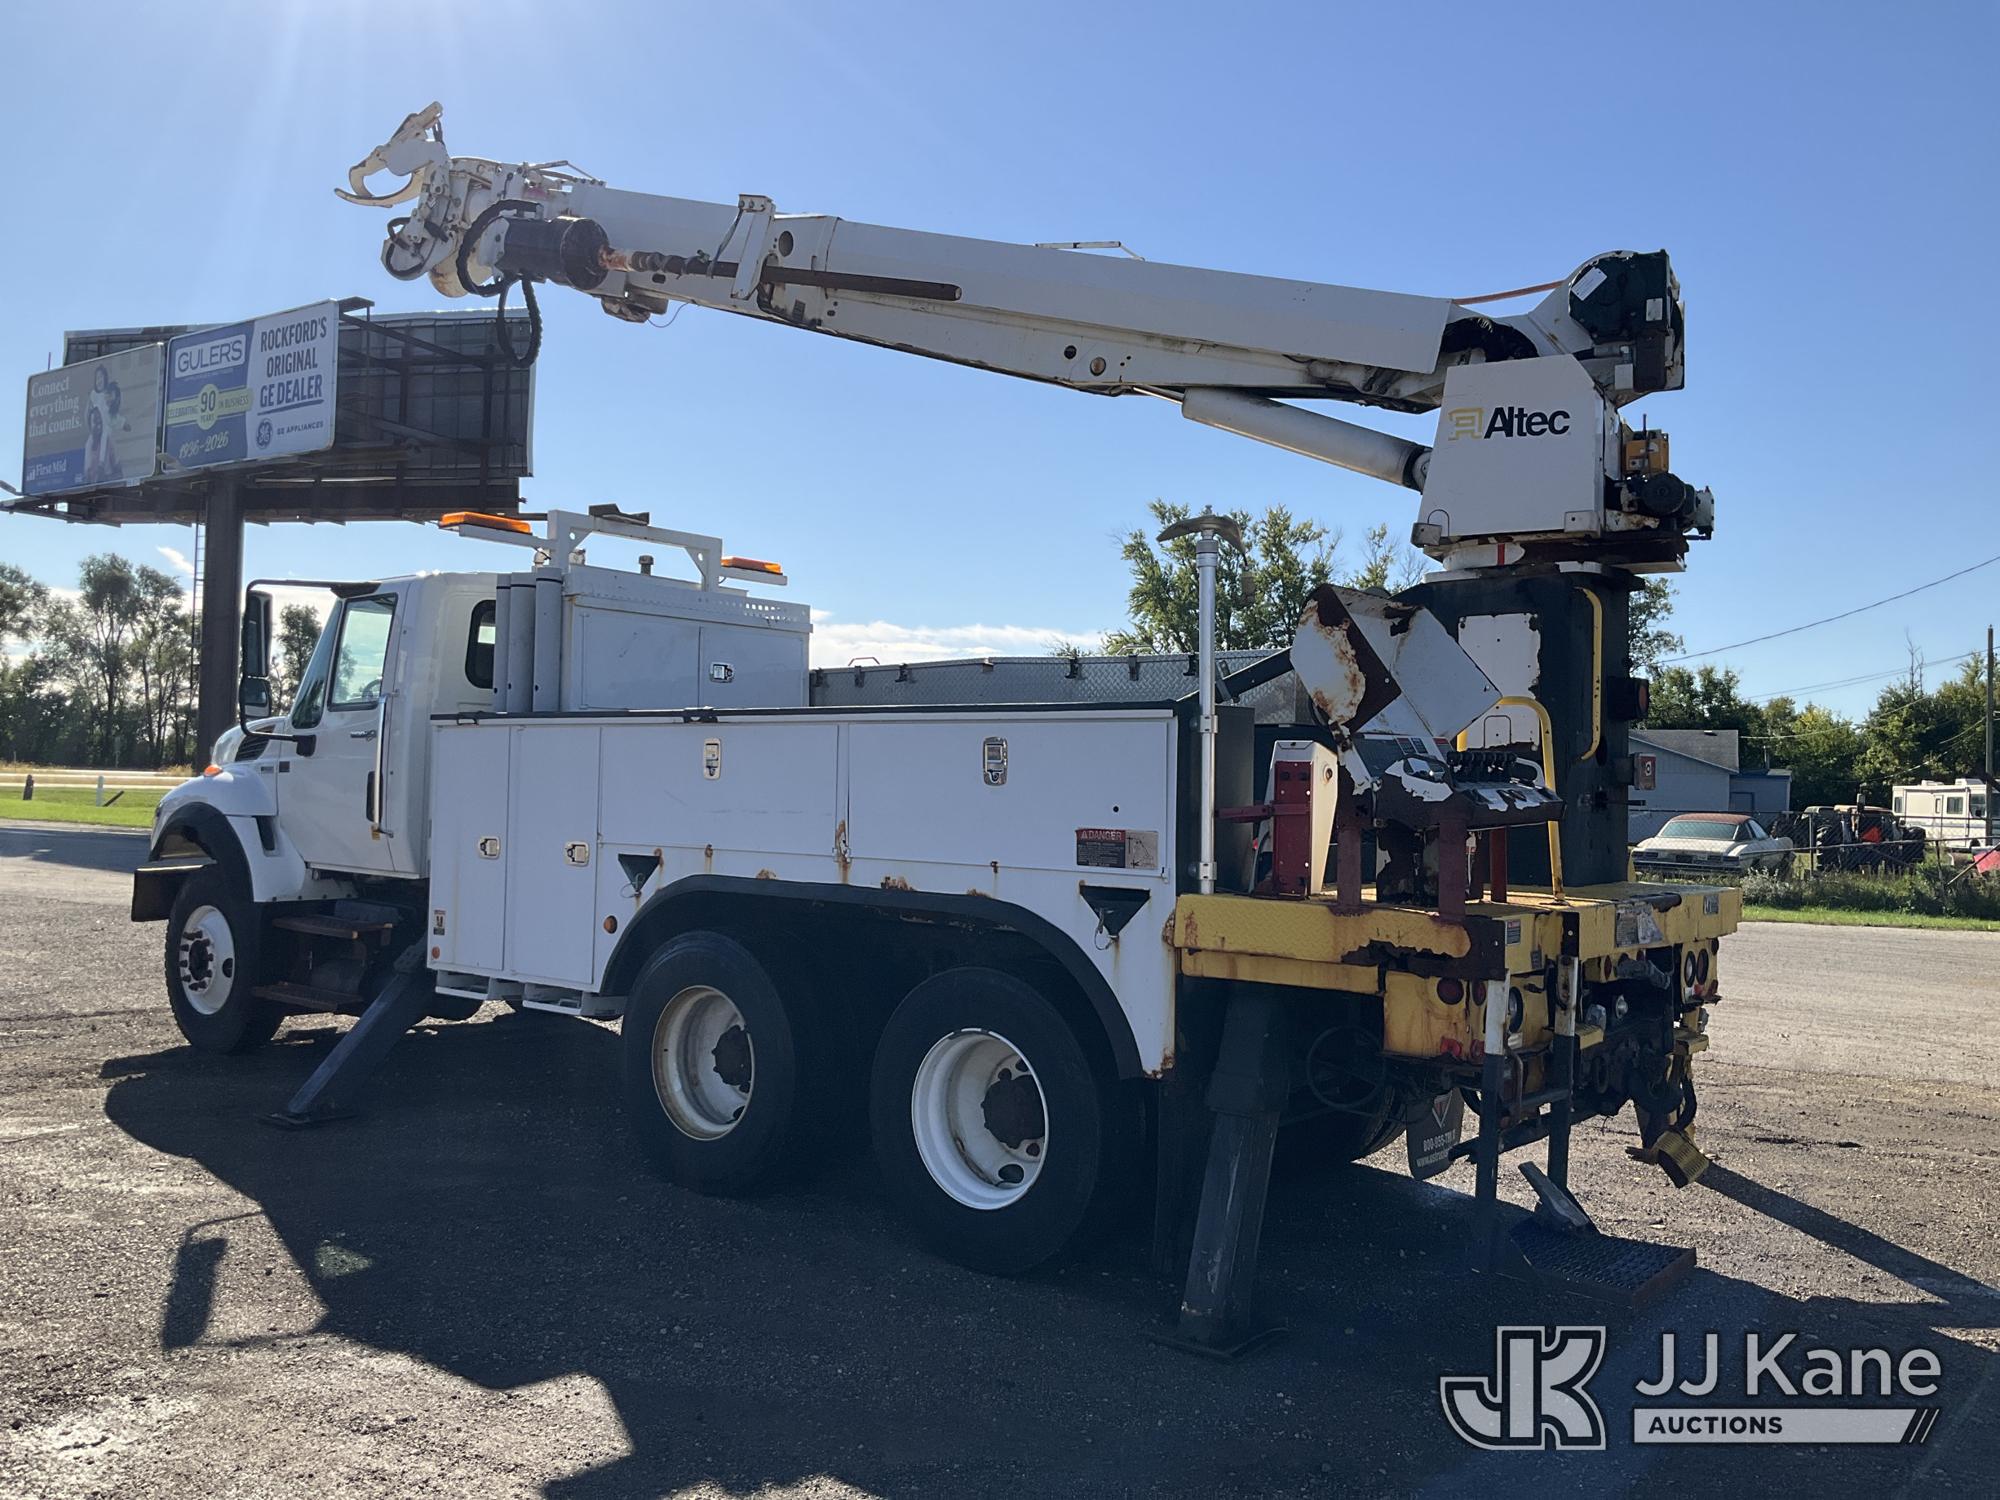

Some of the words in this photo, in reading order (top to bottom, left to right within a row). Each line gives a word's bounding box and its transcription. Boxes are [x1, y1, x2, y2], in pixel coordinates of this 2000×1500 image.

[260, 316, 327, 353] ROCKFORD'S
[177, 340, 243, 373] GULER'S
[266, 347, 318, 378] ORIGINAL
[31, 377, 69, 398] Connect
[260, 383, 275, 408] GE
[276, 374, 322, 405] DEALER
[29, 395, 80, 418] everything
[200, 390, 216, 413] 90
[29, 421, 47, 438] that
[286, 420, 324, 434] APPLIANCES
[1483, 406, 1571, 440] Altec
[35, 462, 52, 477] First
[53, 458, 67, 473] Mid
[1088, 830, 1122, 841] DANGER
